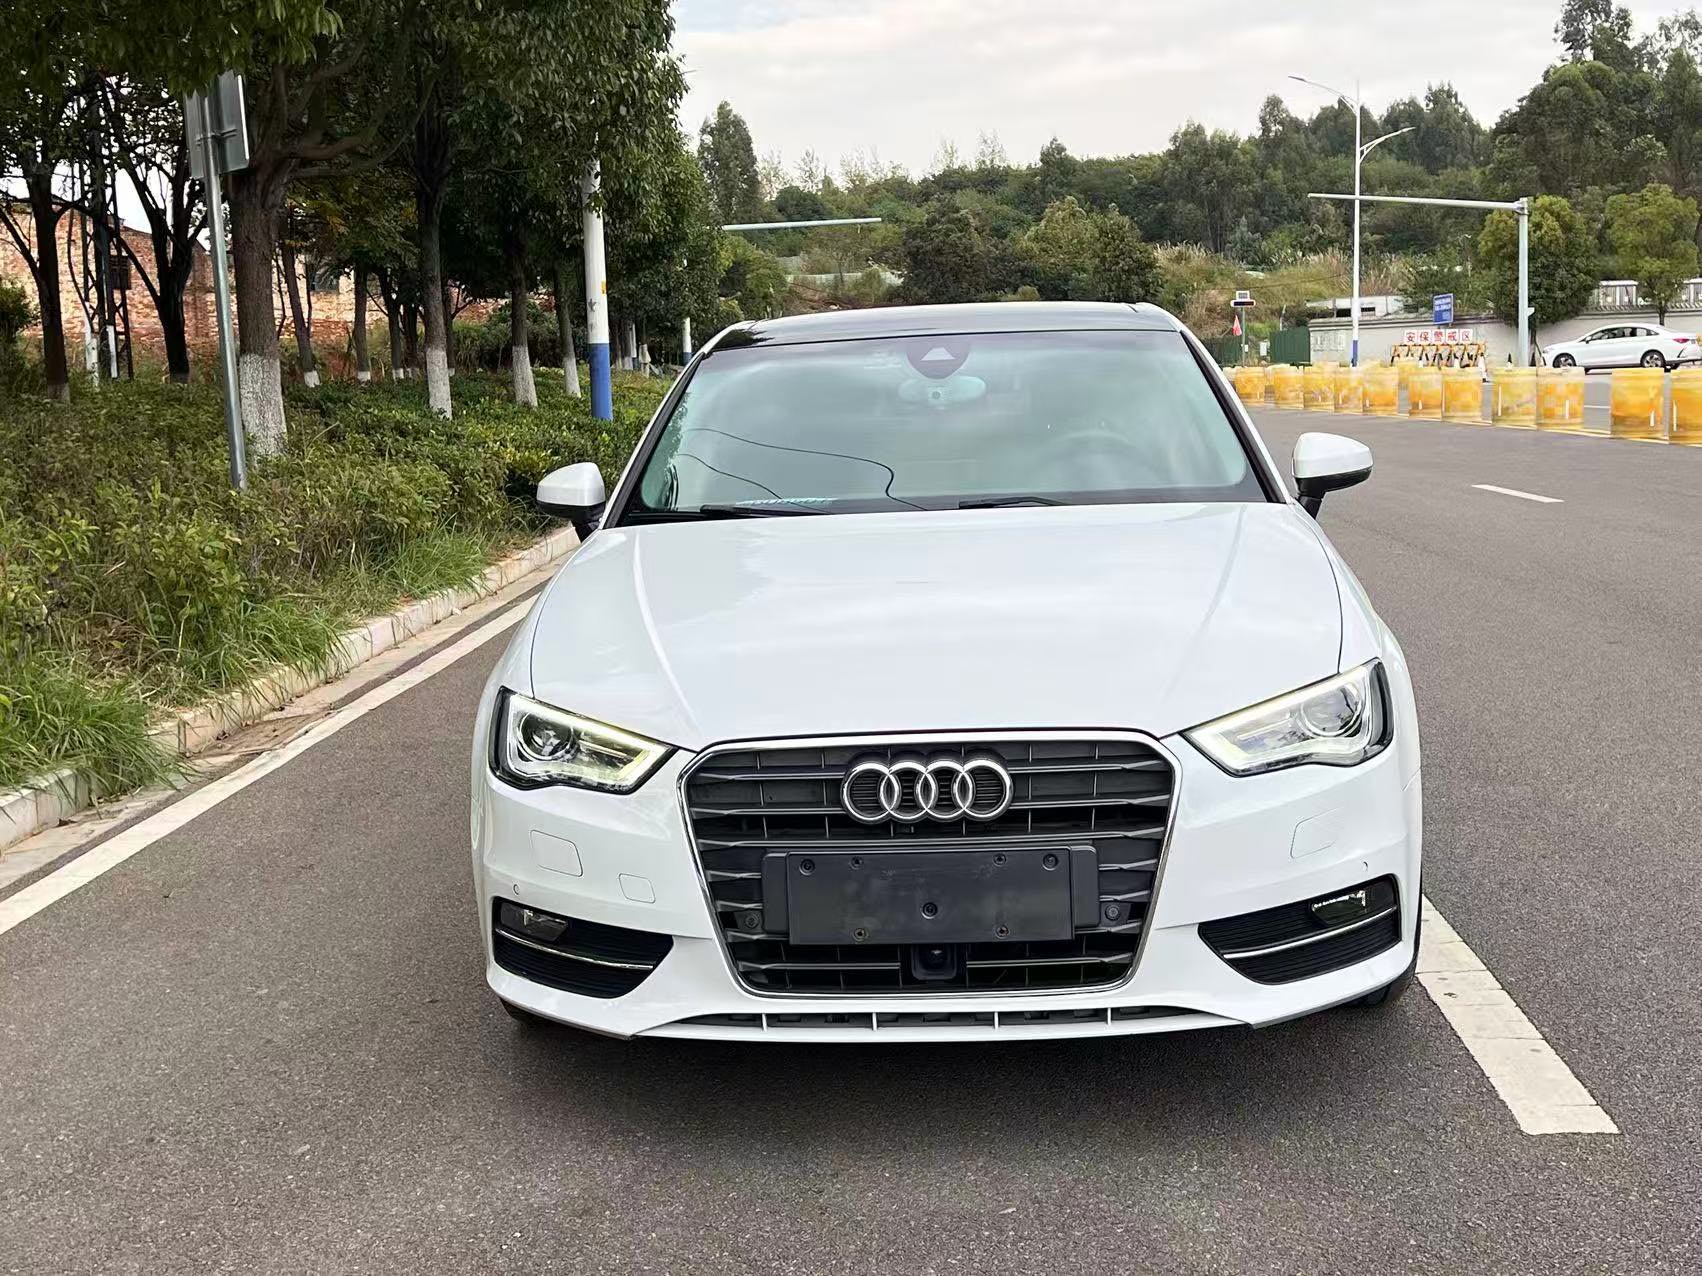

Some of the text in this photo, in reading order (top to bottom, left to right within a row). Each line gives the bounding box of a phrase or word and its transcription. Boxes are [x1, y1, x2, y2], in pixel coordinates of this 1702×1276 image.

[1405, 330, 1472, 342] 安保警戒区
